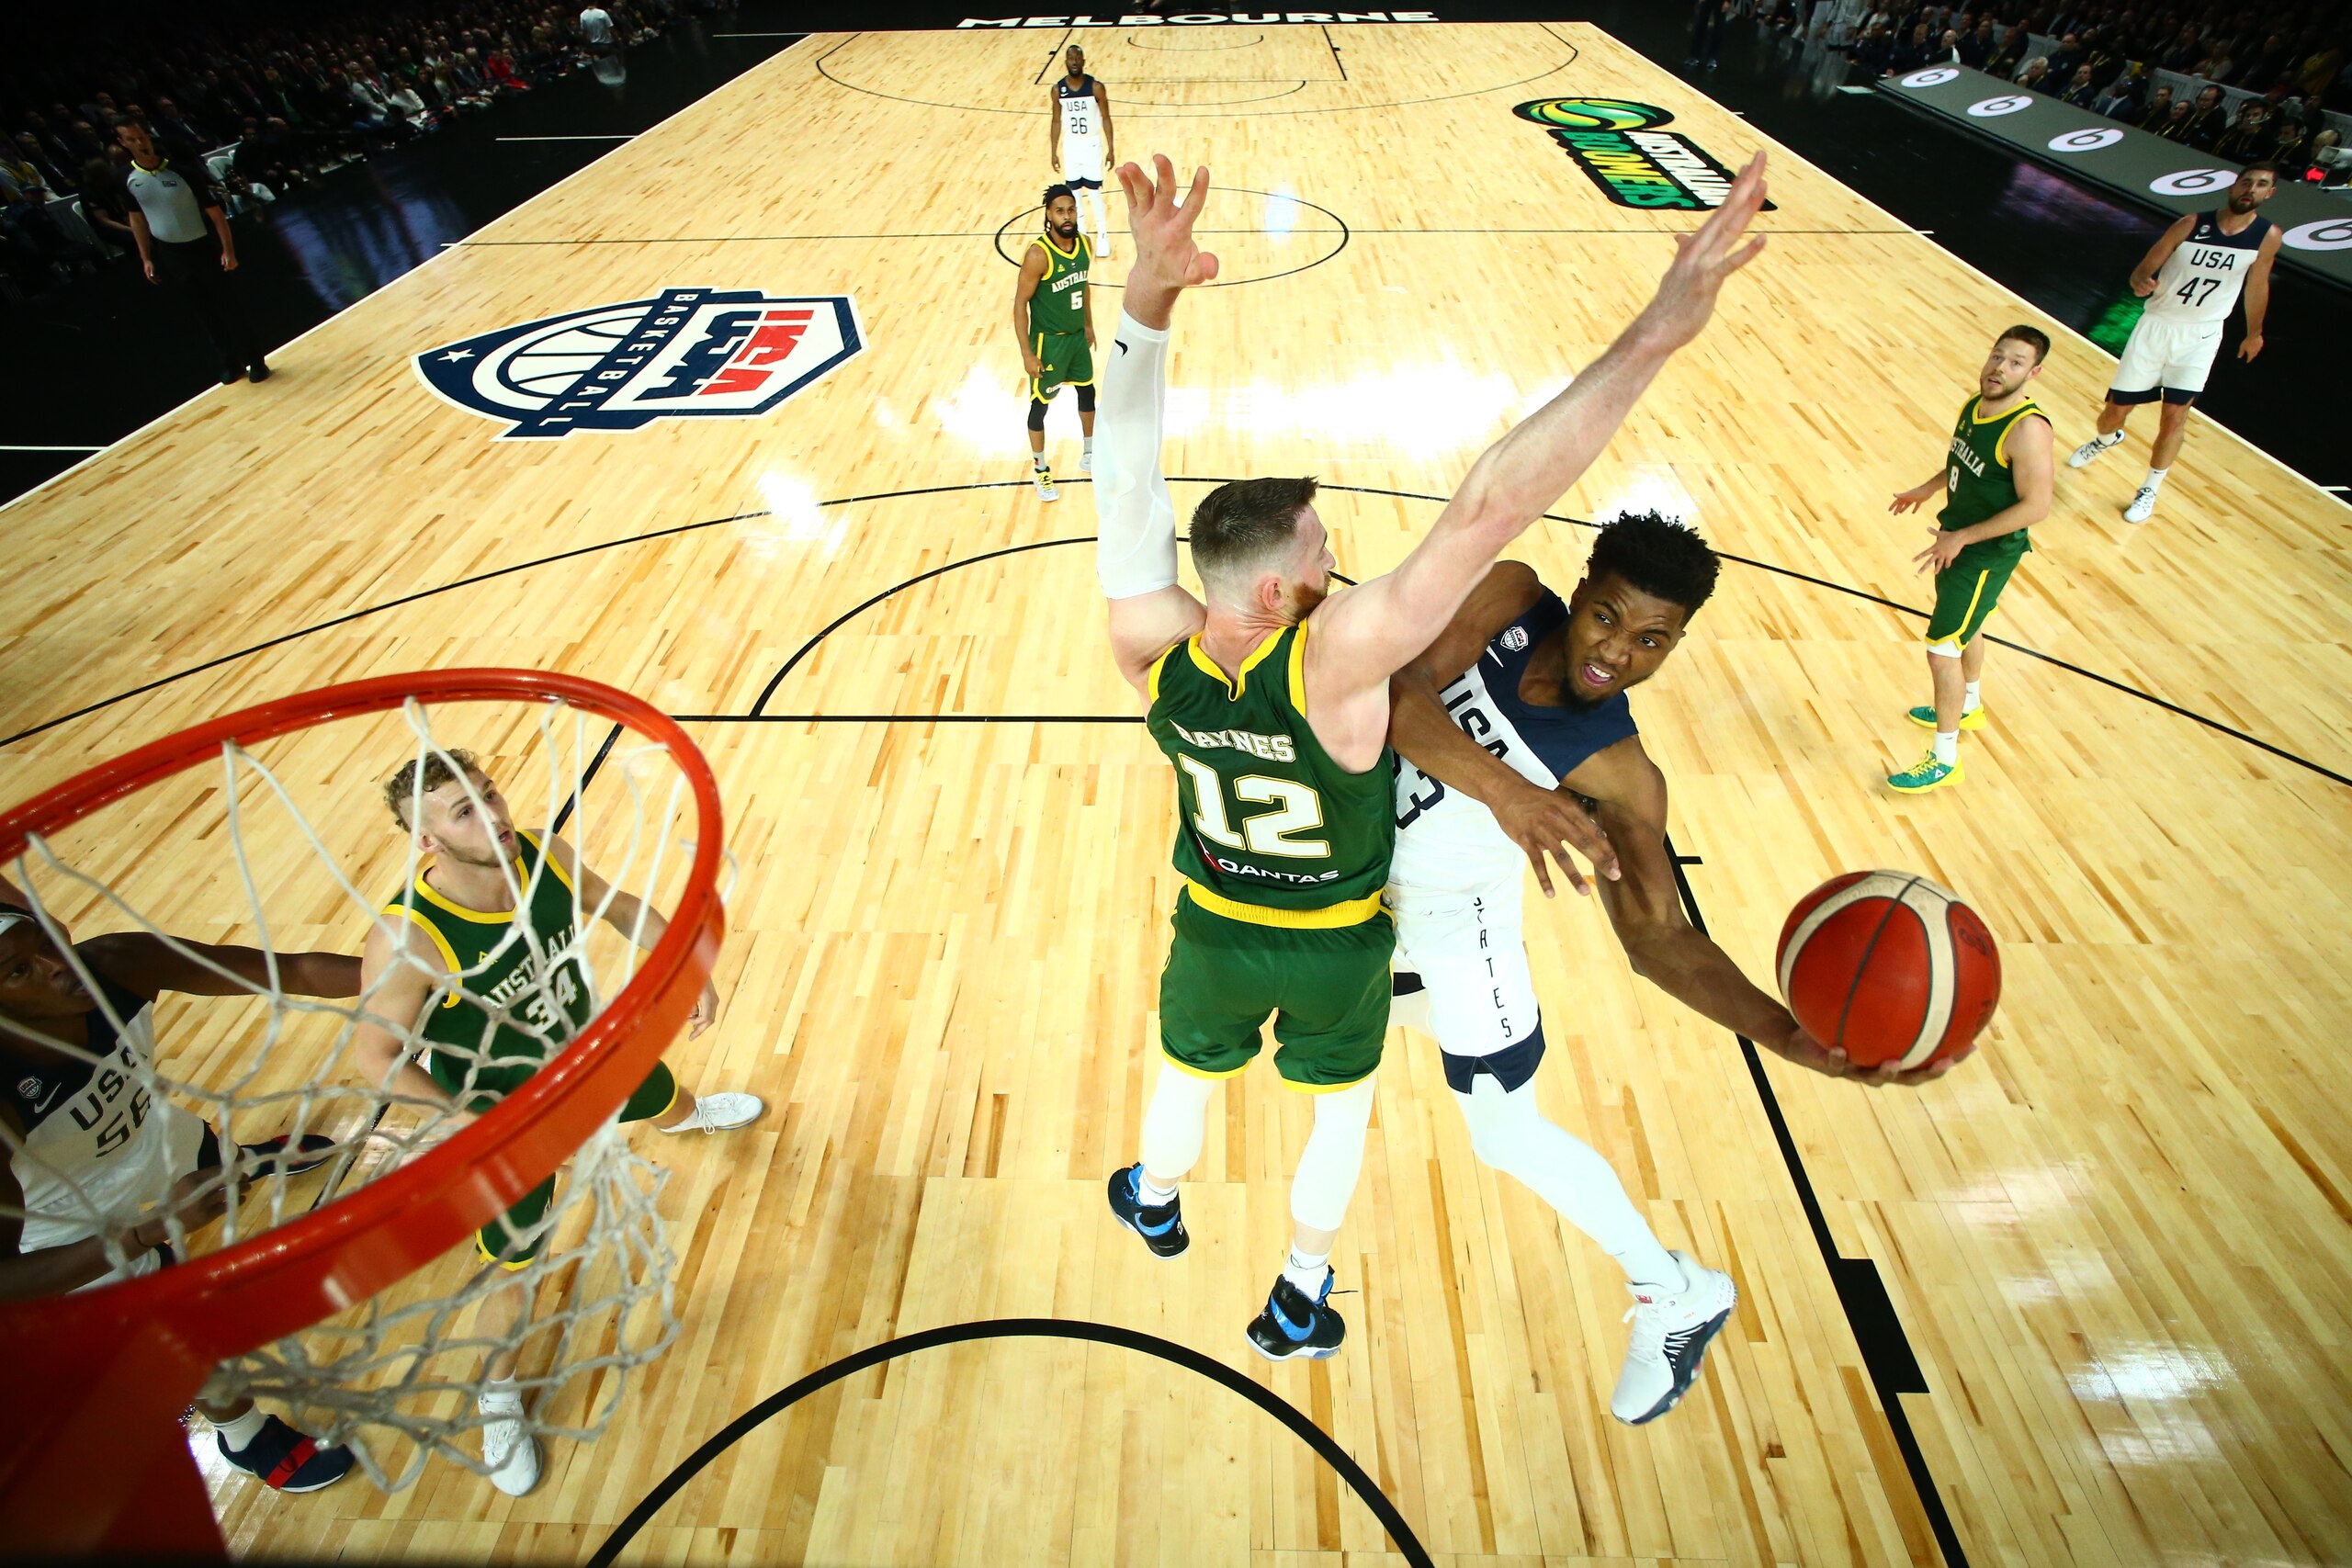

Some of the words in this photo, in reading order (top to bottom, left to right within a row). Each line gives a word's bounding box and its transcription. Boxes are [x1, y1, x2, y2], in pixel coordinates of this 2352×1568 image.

[956, 10, 1440, 28] MELBOURNE
[1066, 100, 1088, 112] USA
[1070, 117, 1088, 135] 26
[1561, 131, 1697, 208] BOOMERS
[2190, 248, 2236, 271] USA
[1070, 289, 1083, 310] 5
[2176, 276, 2222, 308] 47
[537, 292, 699, 426] BASKETBALL
[632, 309, 815, 401] USA
[1177, 751, 1332, 859] 12
[1216, 857, 1340, 884] QANTAS
[525, 965, 578, 1038] 34
[96, 1086, 151, 1158] 56
